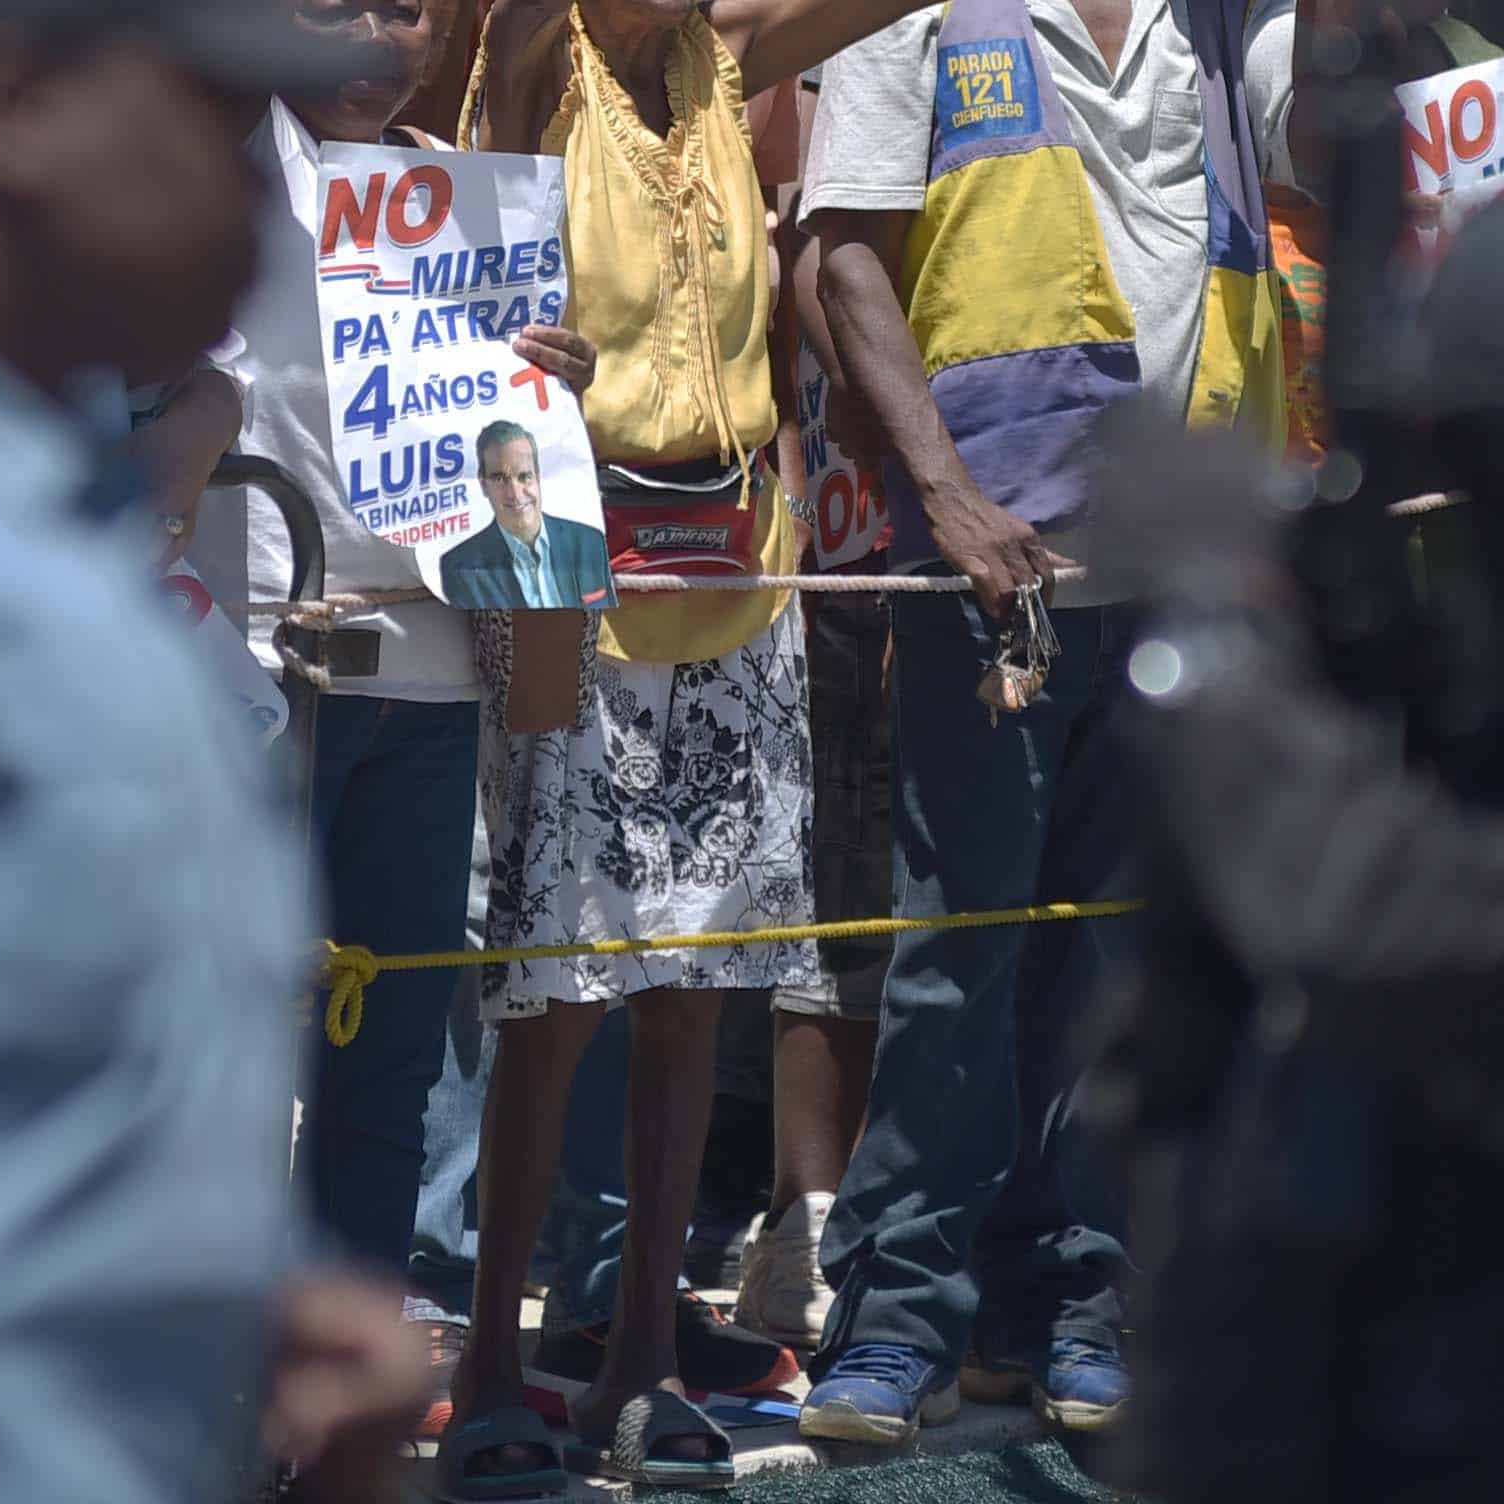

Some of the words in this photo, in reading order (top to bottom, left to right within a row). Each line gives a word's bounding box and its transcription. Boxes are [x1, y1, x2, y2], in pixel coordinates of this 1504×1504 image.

[947, 51, 1015, 75] PARADA
[954, 70, 1015, 108] 121
[951, 102, 1025, 129] CIENFUEGO
[1403, 78, 1497, 195] NO
[319, 164, 454, 259] NO
[410, 236, 563, 300] MIRES
[332, 309, 400, 364] PA'
[411, 290, 563, 353] ATRAS
[343, 363, 396, 441] 4
[399, 370, 499, 421] AÑOS
[348, 432, 466, 508] LUIS
